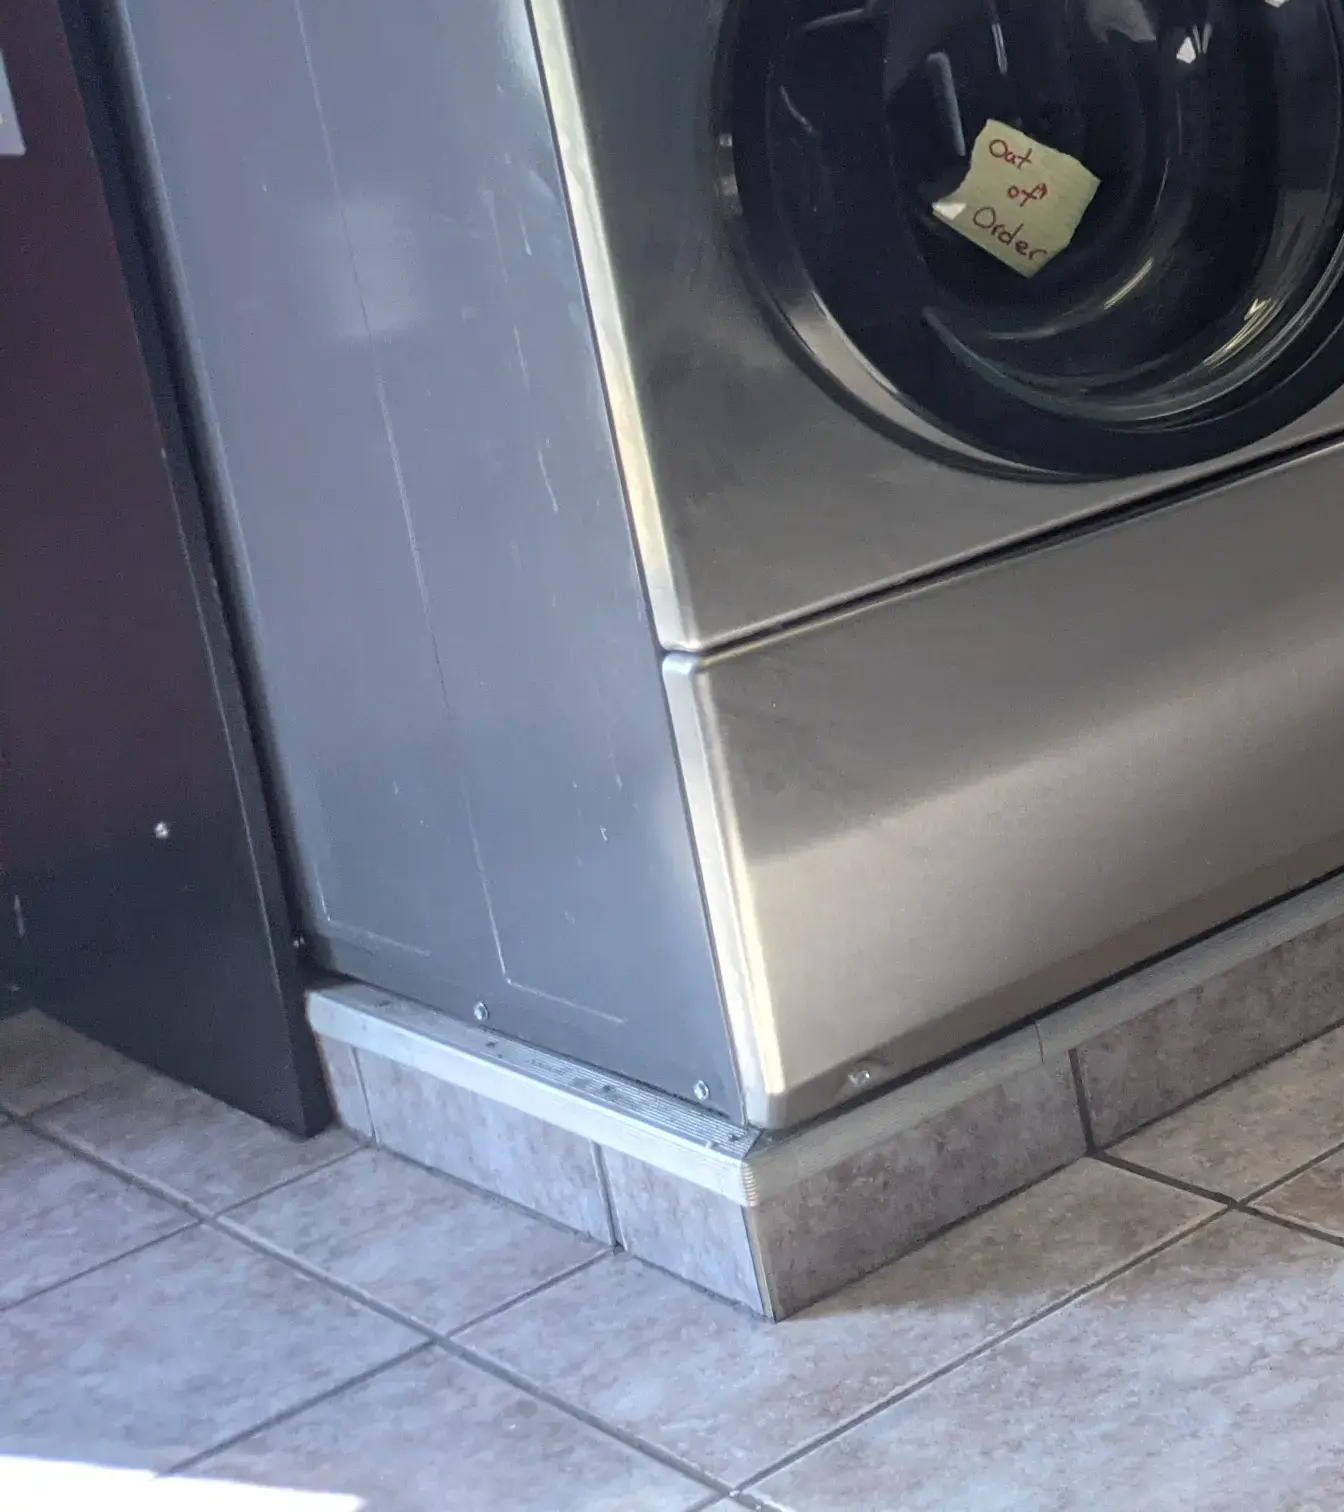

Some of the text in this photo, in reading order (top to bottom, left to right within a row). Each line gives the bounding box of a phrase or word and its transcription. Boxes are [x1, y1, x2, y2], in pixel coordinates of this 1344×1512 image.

[989, 138, 1033, 170] Out
[1007, 182, 1048, 208] of
[973, 206, 1048, 260] Order
